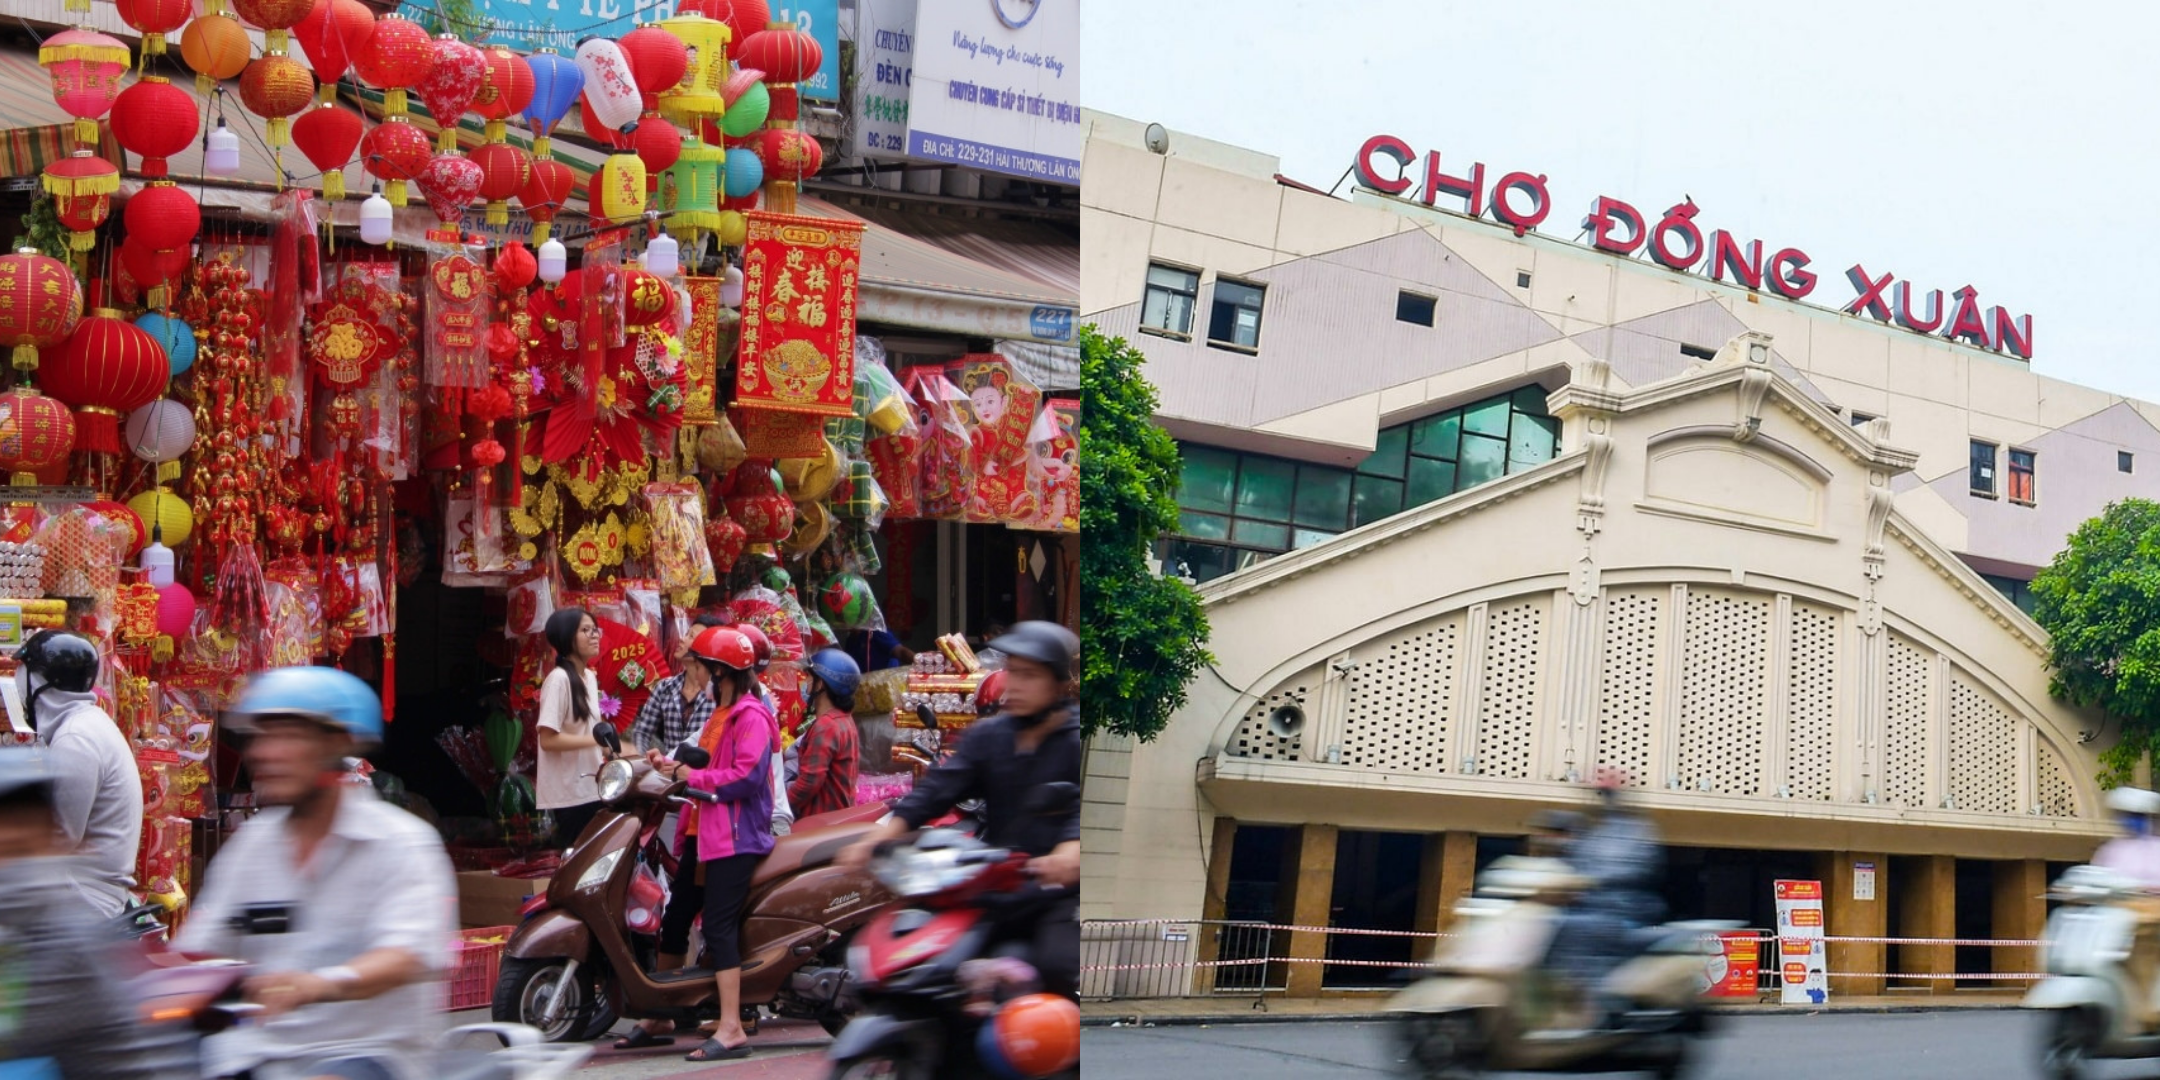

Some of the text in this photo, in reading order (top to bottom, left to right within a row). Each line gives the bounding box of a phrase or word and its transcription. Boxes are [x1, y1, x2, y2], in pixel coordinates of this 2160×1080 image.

[549, 25, 576, 49] ÔNG
[1006, 44, 1021, 62] cho
[876, 58, 902, 85] ĐÈN
[949, 79, 978, 103] CHUYÊN
[979, 85, 1000, 108] CUNG
[1001, 86, 1016, 110] CẤP
[1026, 92, 1046, 117] THIẾT
[1056, 99, 1073, 125] ĐIỆN
[957, 142, 994, 165] 229-231
[995, 149, 1010, 168] HẢI
[1011, 155, 1047, 178] THƯỢNG
[1049, 160, 1066, 178] LÃN
[1353, 133, 1552, 238] CHỢ
[1035, 308, 1068, 325] 227
[1844, 263, 2034, 360] XUÂN
[611, 642, 646, 662] 2025
